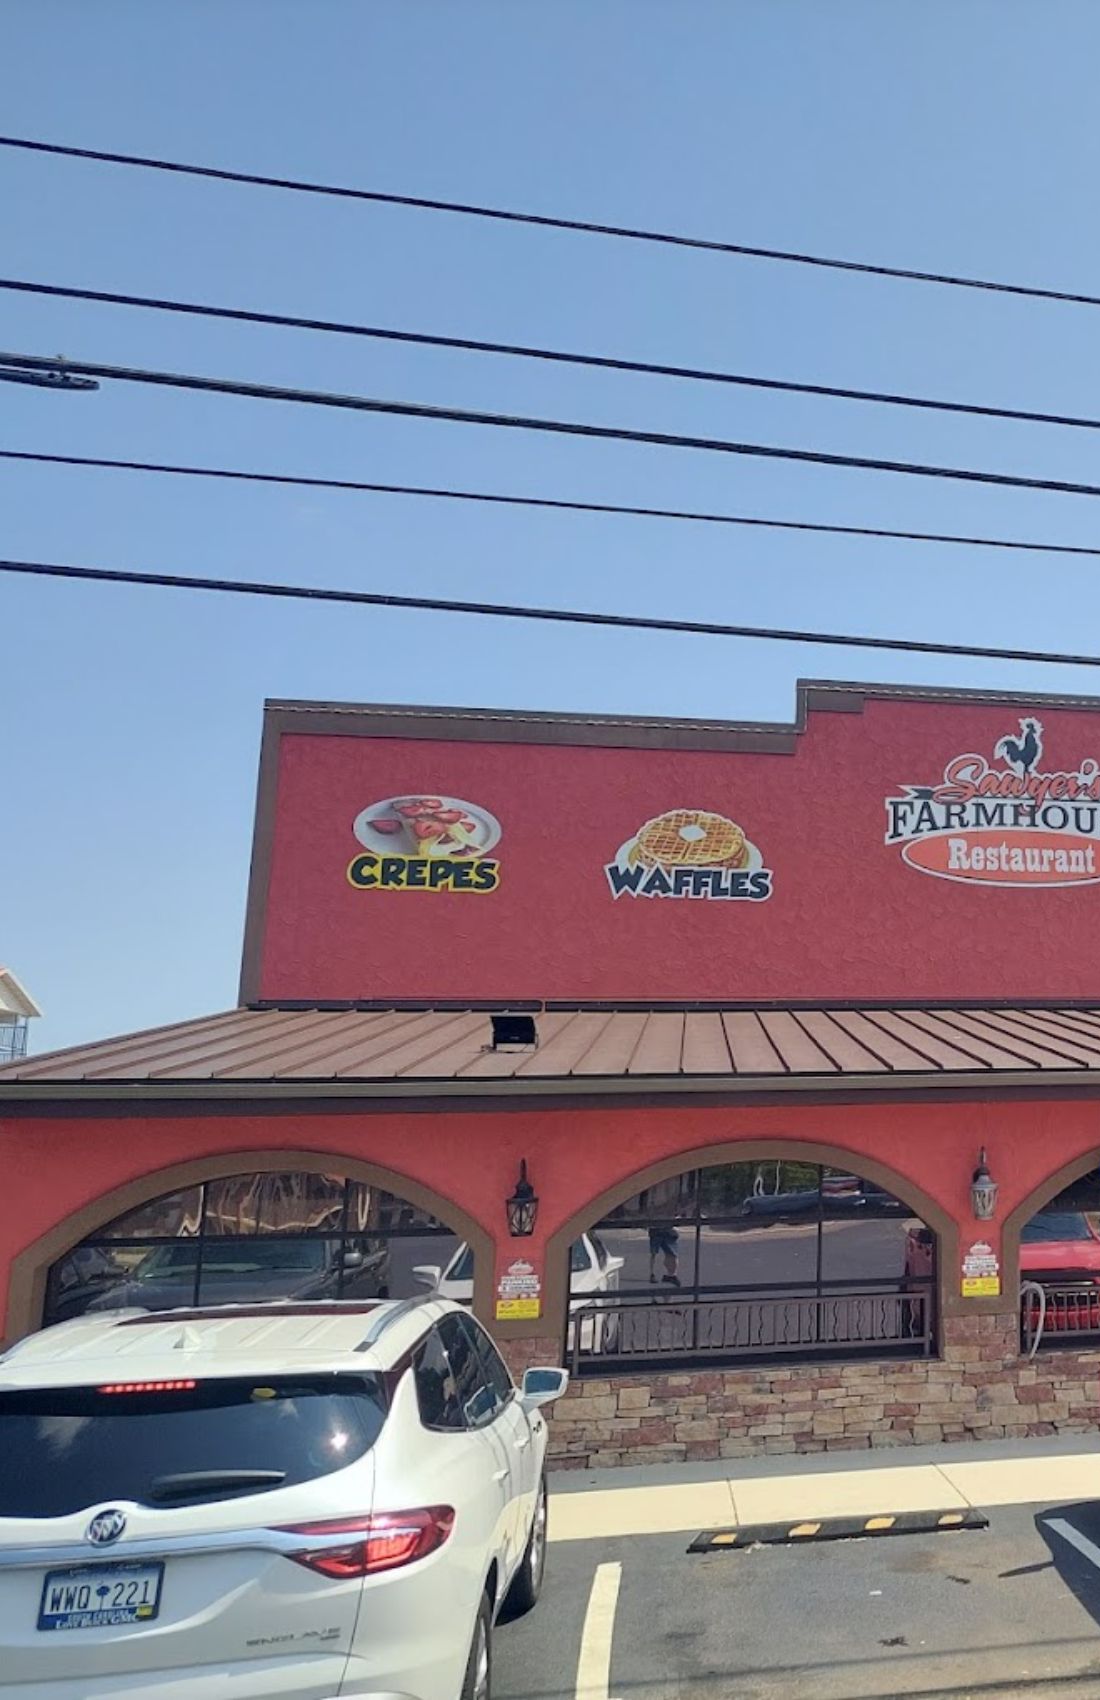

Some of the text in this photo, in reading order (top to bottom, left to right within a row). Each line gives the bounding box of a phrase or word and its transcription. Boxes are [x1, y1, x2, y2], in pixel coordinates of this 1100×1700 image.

[348, 855, 498, 891] CREPES
[947, 838, 1096, 874] Restaurant
[606, 863, 772, 899] WAFFLES
[111, 1580, 151, 1607] 221
